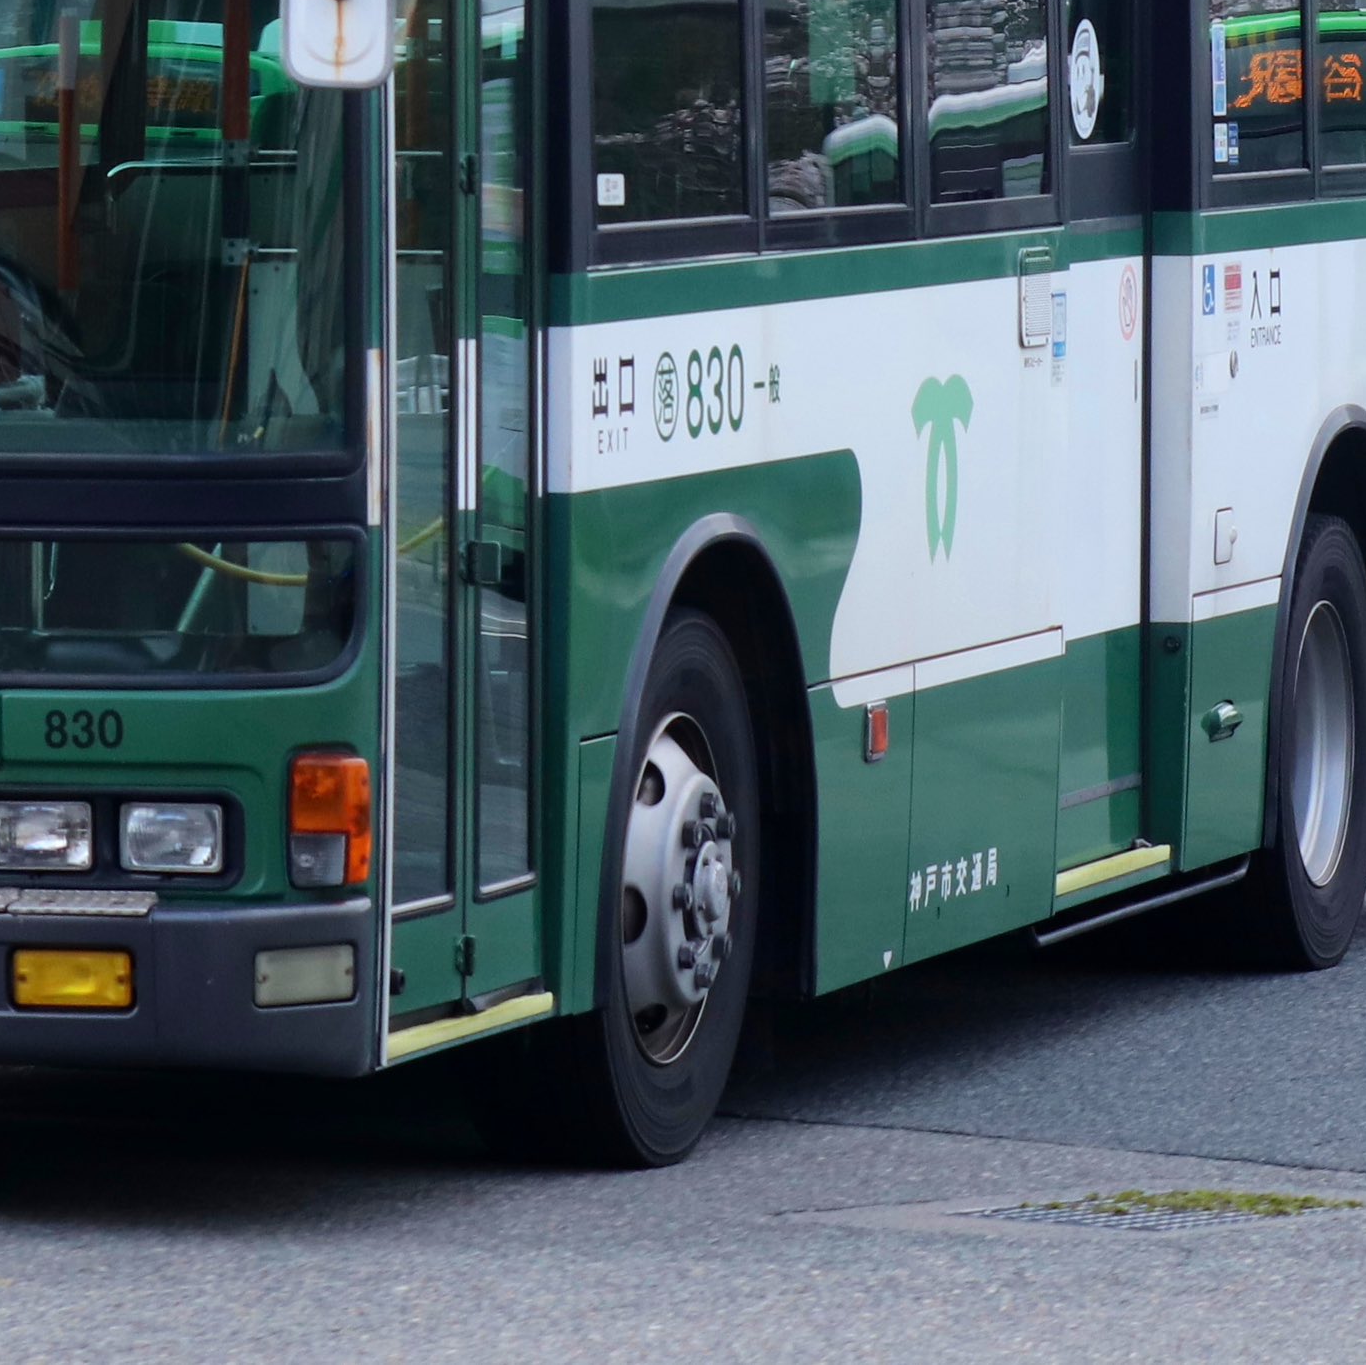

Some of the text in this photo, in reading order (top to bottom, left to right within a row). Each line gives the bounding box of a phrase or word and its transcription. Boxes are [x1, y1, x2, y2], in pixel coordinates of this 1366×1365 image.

[1250, 268, 1282, 320] 入口
[1250, 324, 1282, 348] ENTRANCE
[592, 355, 635, 420] 出口
[686, 343, 745, 440] 830
[753, 363, 781, 404] 一般
[597, 427, 629, 455] EXIT
[44, 709, 123, 750] 830
[909, 846, 998, 913] 神戸市交通局
